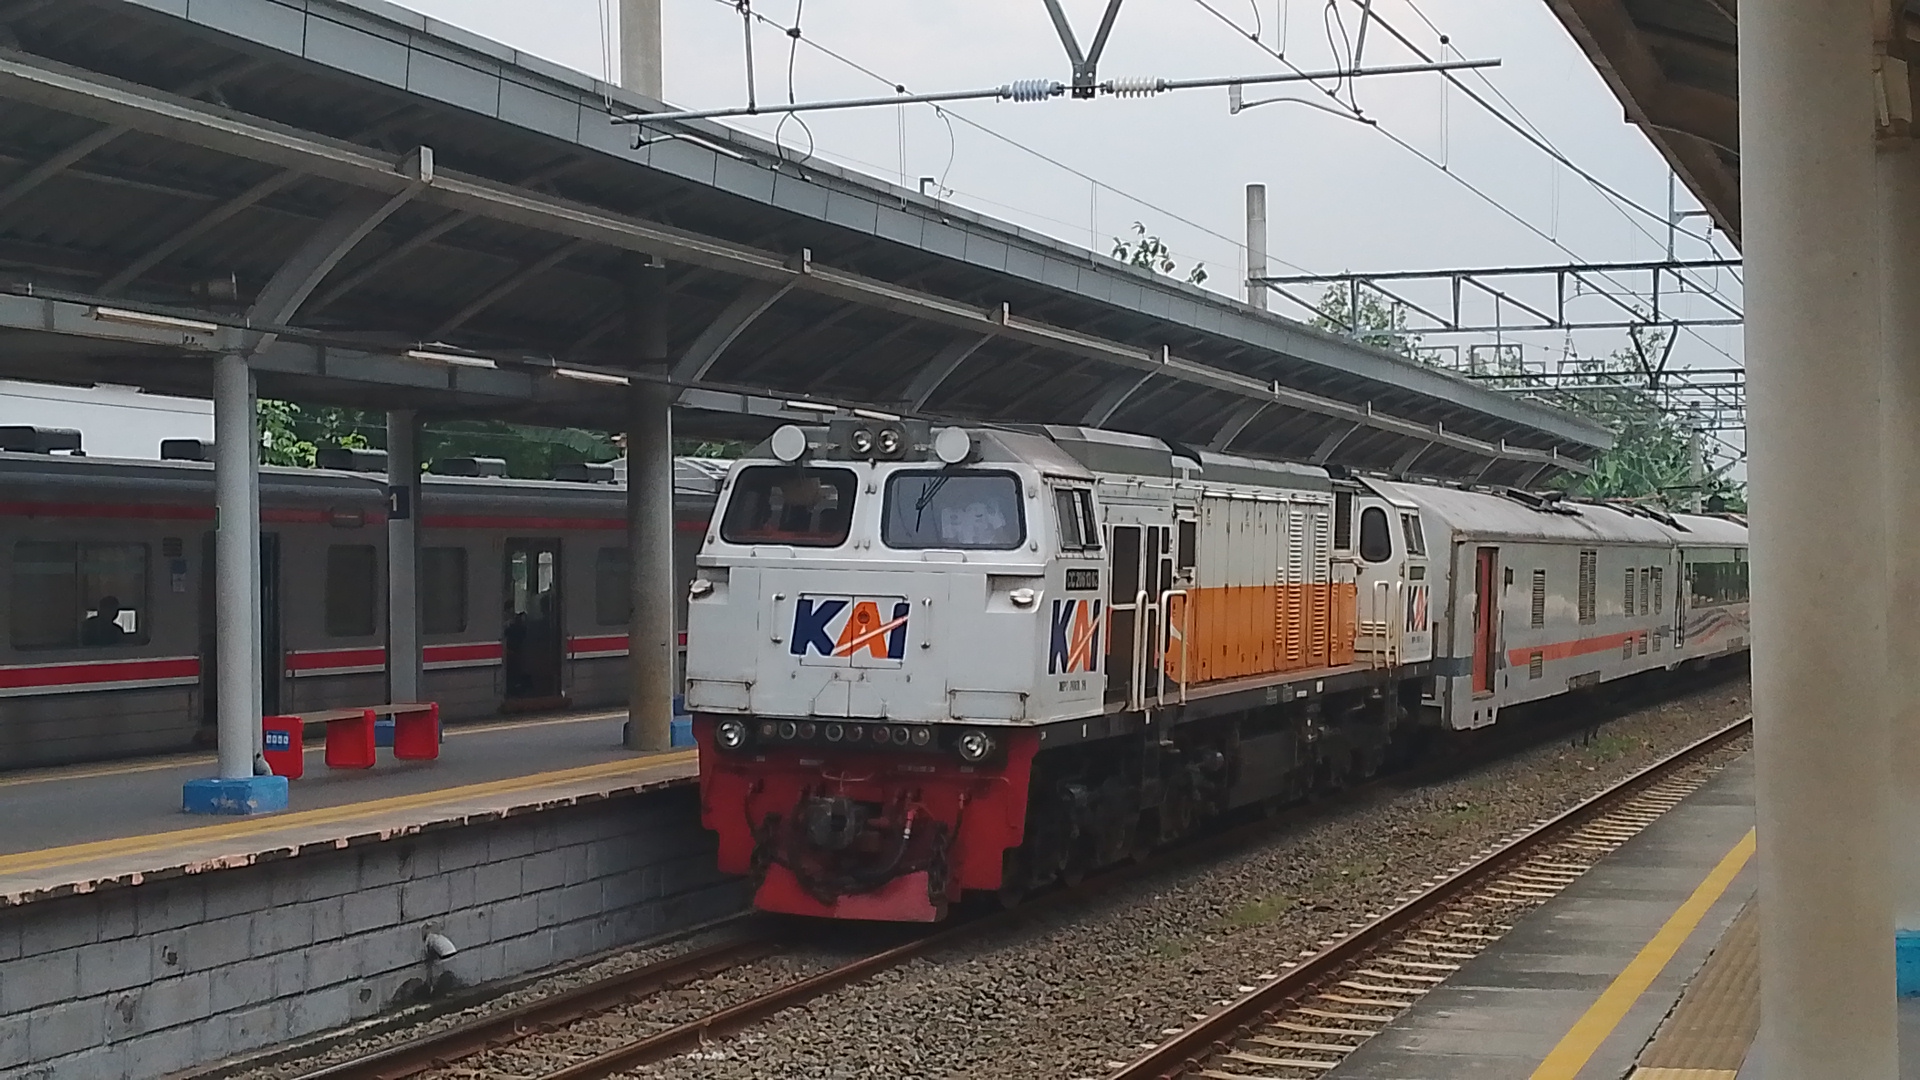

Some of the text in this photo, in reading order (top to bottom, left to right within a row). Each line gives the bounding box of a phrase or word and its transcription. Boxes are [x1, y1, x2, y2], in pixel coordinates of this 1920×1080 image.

[389, 493, 398, 512] 1
[789, 598, 911, 661] KAI
[1407, 585, 1430, 633] KAI
[1048, 598, 1102, 676] KAI
